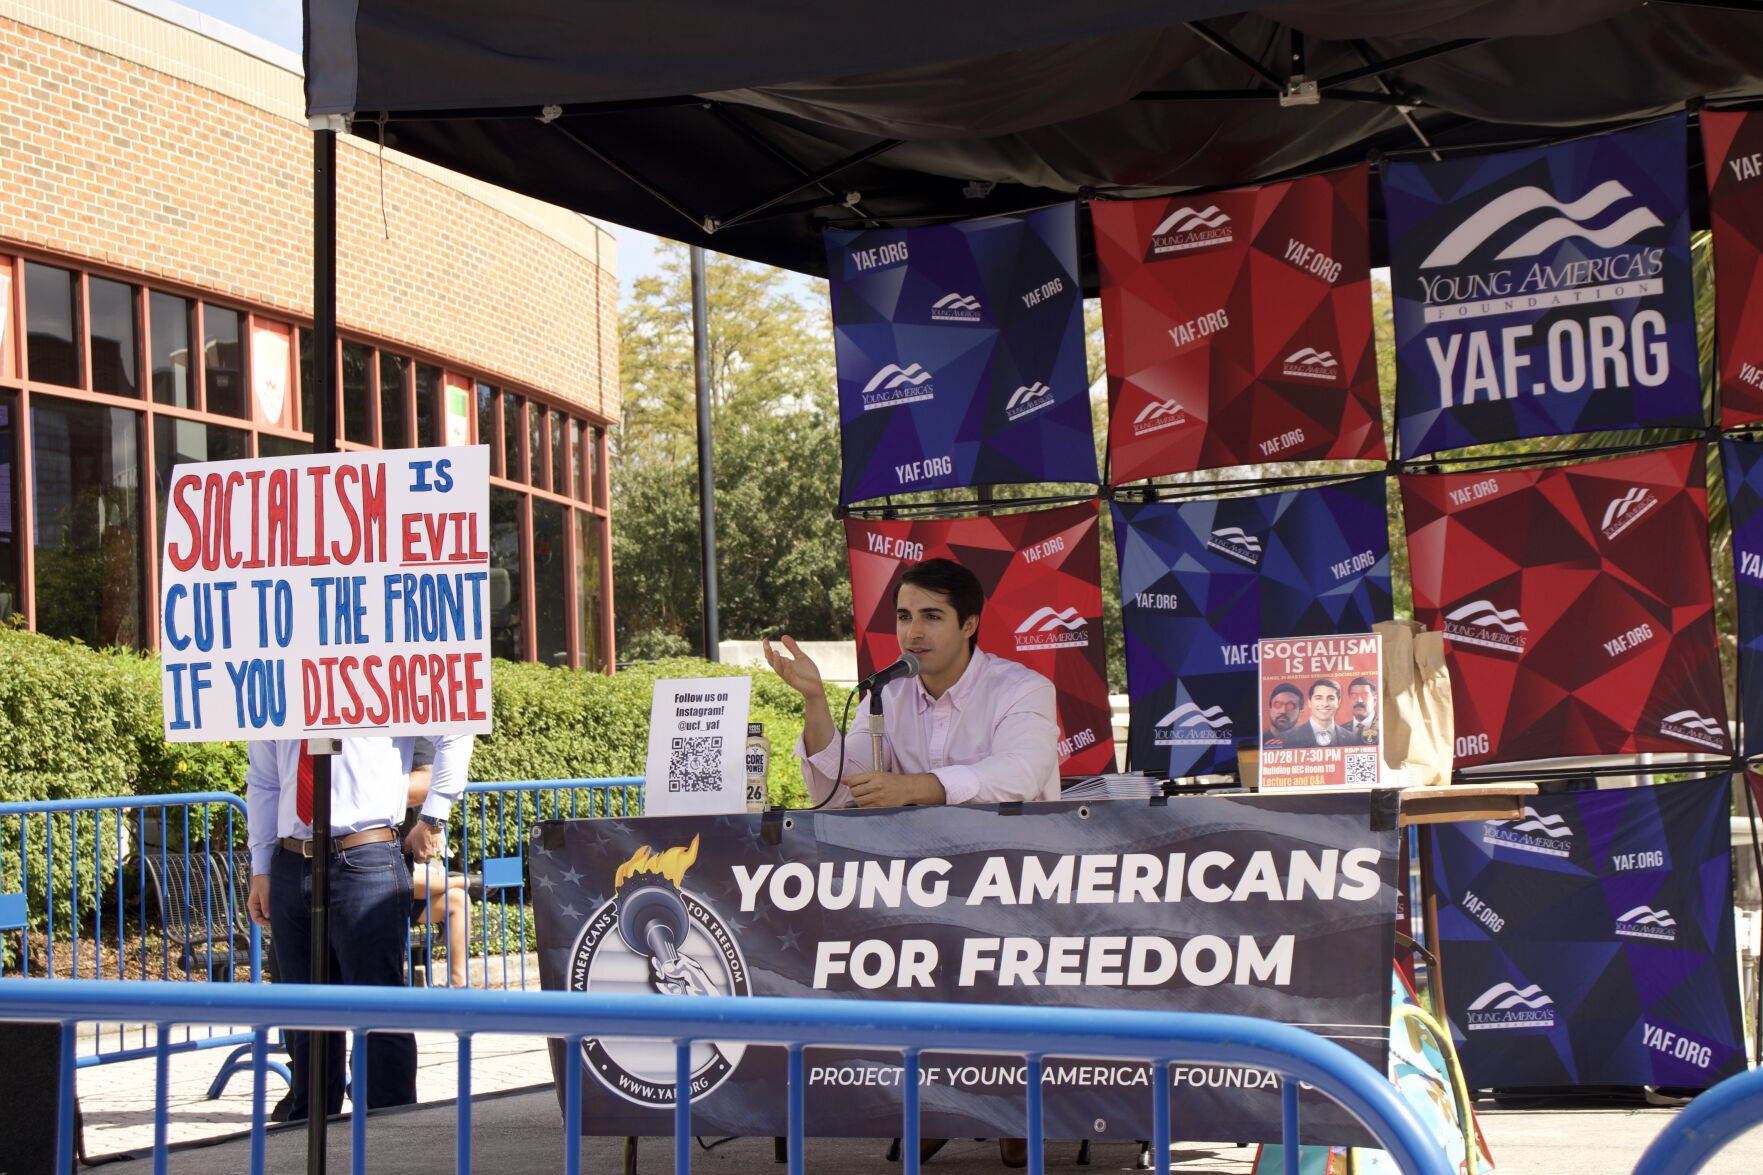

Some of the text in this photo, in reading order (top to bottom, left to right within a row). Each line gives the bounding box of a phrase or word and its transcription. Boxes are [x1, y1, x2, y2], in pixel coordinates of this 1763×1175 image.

[1152, 235, 1183, 247] YOUNG
[852, 241, 908, 271] YAF.ORG
[1284, 238, 1342, 283] YAF.ORG
[1417, 247, 1665, 304] YOUNG AMERICA'S
[1022, 277, 1063, 308] YAF.ORG
[1438, 283, 1648, 319] FOUNDATION
[1168, 308, 1230, 347] YAF.ORG
[1426, 309, 1669, 408] YAF.ORG
[862, 391, 890, 405] YOUNG
[1259, 429, 1305, 456] YAF.ORG
[408, 459, 454, 493] IS
[895, 456, 951, 484] YAF.ORG
[1449, 478, 1498, 505] YAF.ORG
[168, 463, 387, 572] SOCIALISM
[402, 512, 488, 562] EVIL
[867, 532, 923, 561] YAF.ORG
[1023, 536, 1065, 564] YAF.ORG
[1330, 550, 1375, 580] YAF.ORG
[165, 572, 487, 651] CUT TO THE FRONT
[1135, 592, 1178, 610] YAF.ORG
[1014, 631, 1089, 645] YOUNG AMERICA'S
[1444, 621, 1476, 637] YOUNG
[1603, 623, 1653, 657] YAF.ORG
[1263, 638, 1377, 659] SOCIALISM
[1286, 656, 1354, 673] IS EVIL
[166, 653, 487, 730] IF YOU DISSAGREE
[675, 693, 728, 703] Follow us on
[676, 706, 724, 717] Instagram!
[678, 720, 720, 731] @ucf_yaf
[1154, 729, 1184, 740] YOUNG
[746, 754, 764, 765] CORE
[746, 765, 764, 773] POWER
[1264, 750, 1292, 764] 10/28
[1300, 749, 1323, 763] 7:30
[1325, 748, 1341, 761] PM
[746, 786, 762, 800] 26
[1263, 776, 1293, 787] Lecture
[1293, 776, 1309, 786] and
[1484, 825, 1520, 841] YOUNG
[1612, 851, 1664, 872] YAF.ORG
[731, 847, 1381, 912] YOUNG AMERICANS
[1461, 890, 1506, 933] YAF.ORG
[574, 913, 611, 991] AMERICANS
[688, 902, 743, 983] FOR FREEDOM
[812, 935, 1295, 989] FOR FREEDOM
[1466, 1012, 1501, 1024] YOUNG
[1641, 1022, 1712, 1069] YAF.ORG
[808, 1067, 906, 1086] PROJECT
